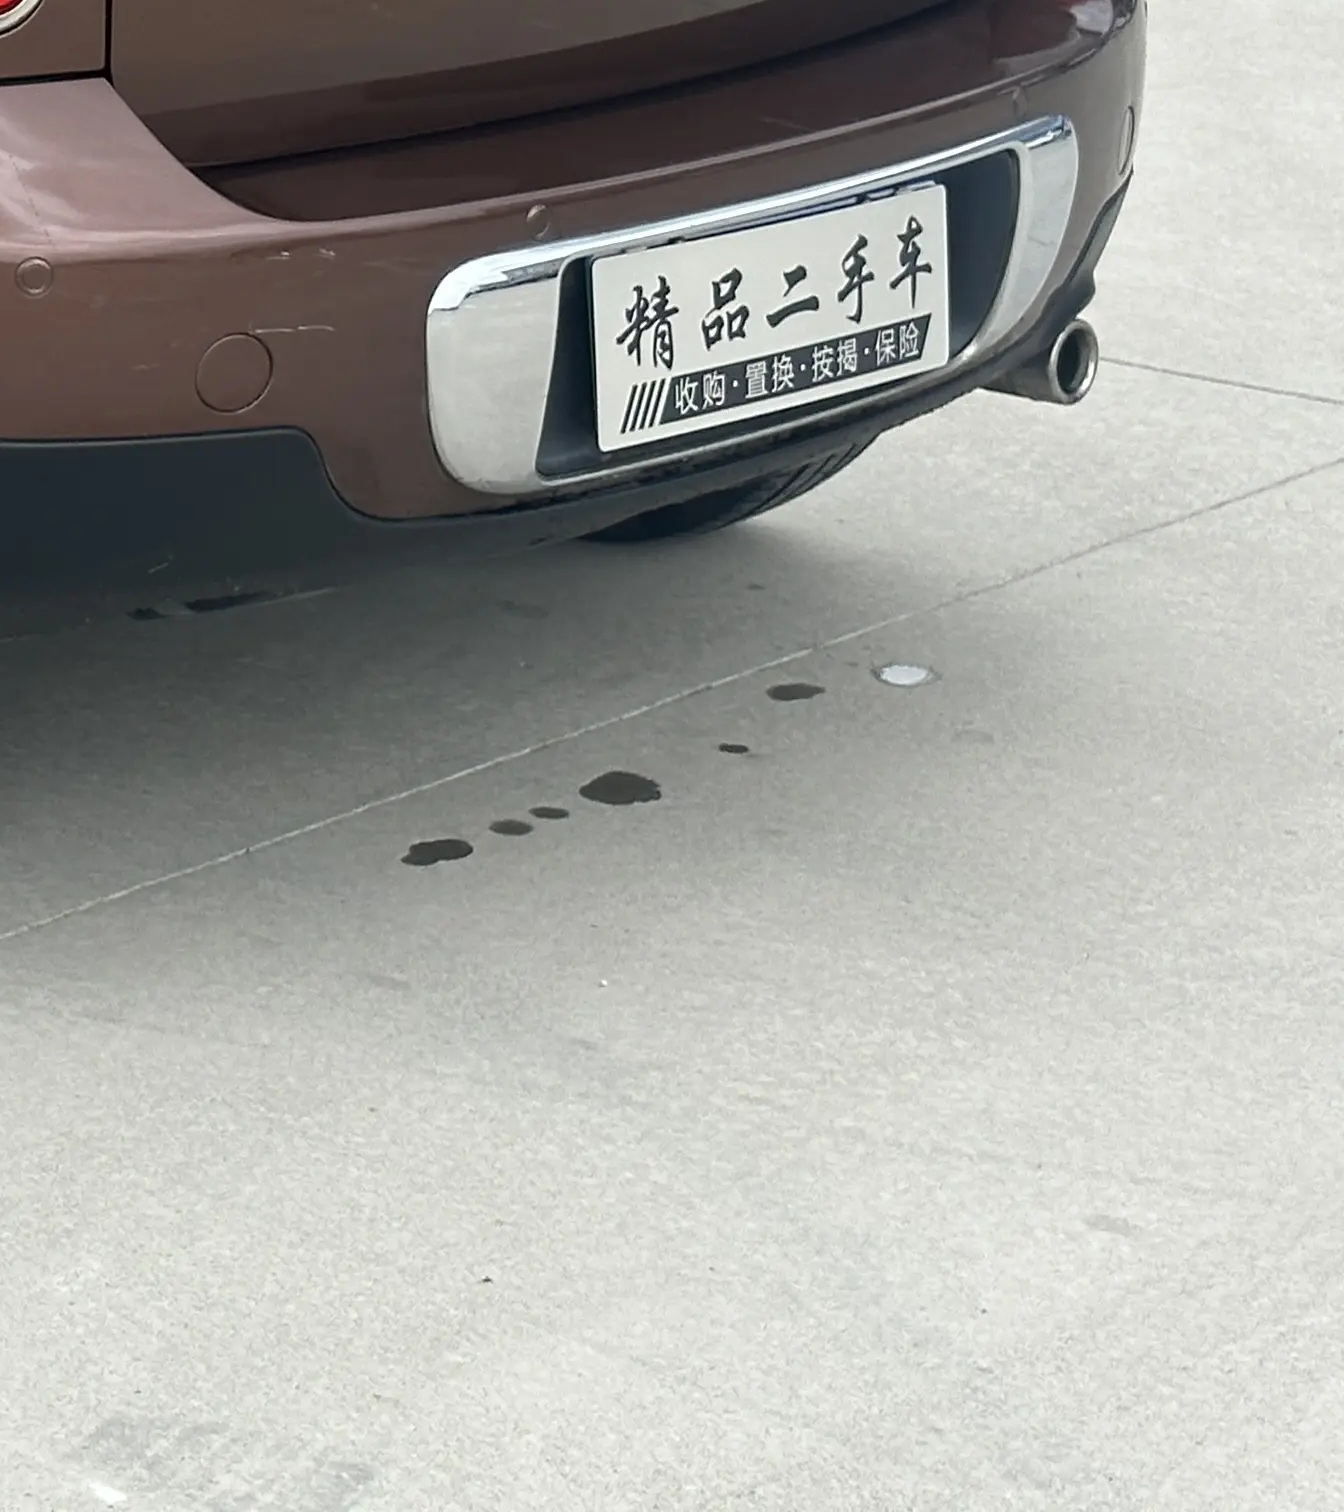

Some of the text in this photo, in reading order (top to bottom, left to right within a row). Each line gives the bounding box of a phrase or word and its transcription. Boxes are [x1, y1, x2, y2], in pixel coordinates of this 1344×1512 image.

[614, 215, 934, 372] 精品二手车
